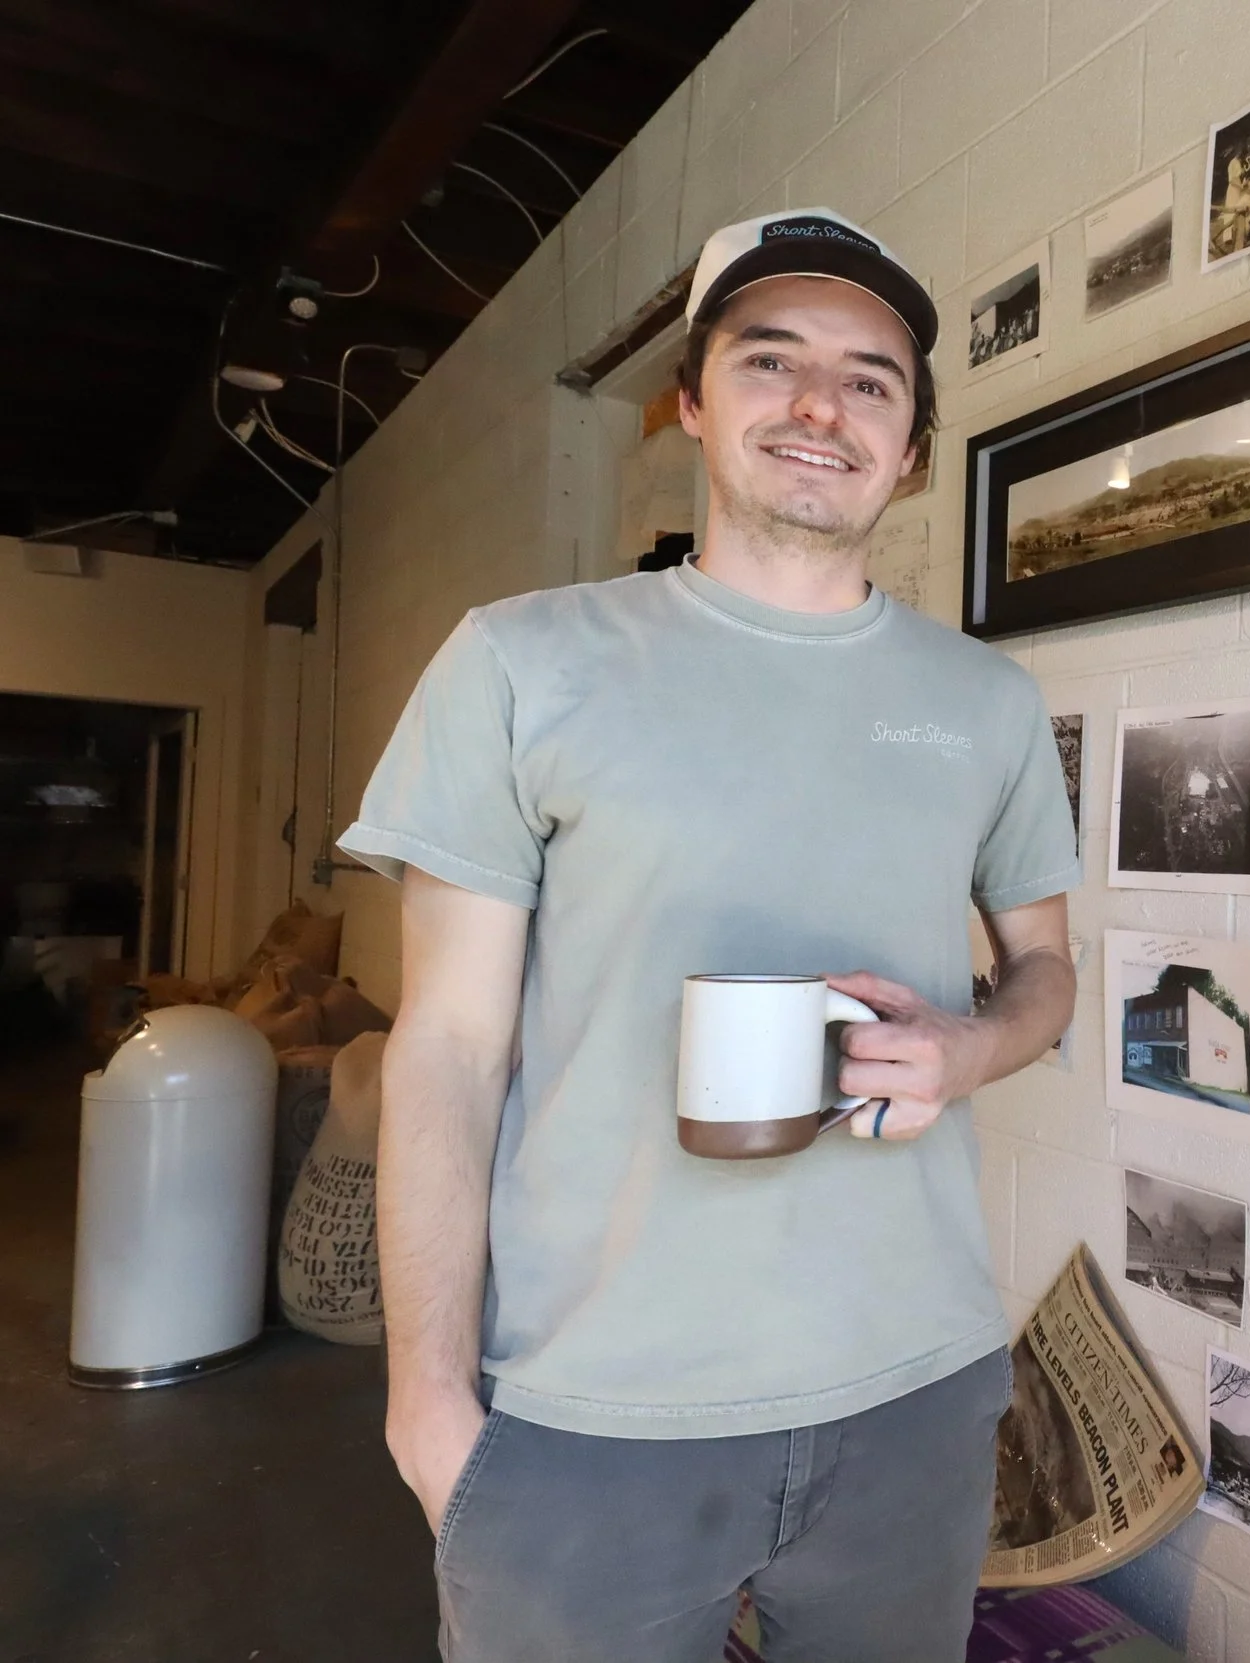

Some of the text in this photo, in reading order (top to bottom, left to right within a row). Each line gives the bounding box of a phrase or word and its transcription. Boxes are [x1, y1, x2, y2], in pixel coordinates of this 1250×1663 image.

[767, 224, 820, 237] Short
[871, 721, 972, 749] Short Sleeves
[1032, 1312, 1048, 1349] FIRE
[1045, 1347, 1083, 1406] LEVELS
[1079, 1403, 1111, 1476] BEACON
[1103, 1473, 1129, 1535] PLANT
[1063, 1312, 1150, 1455] CITIZEN-TIMES
